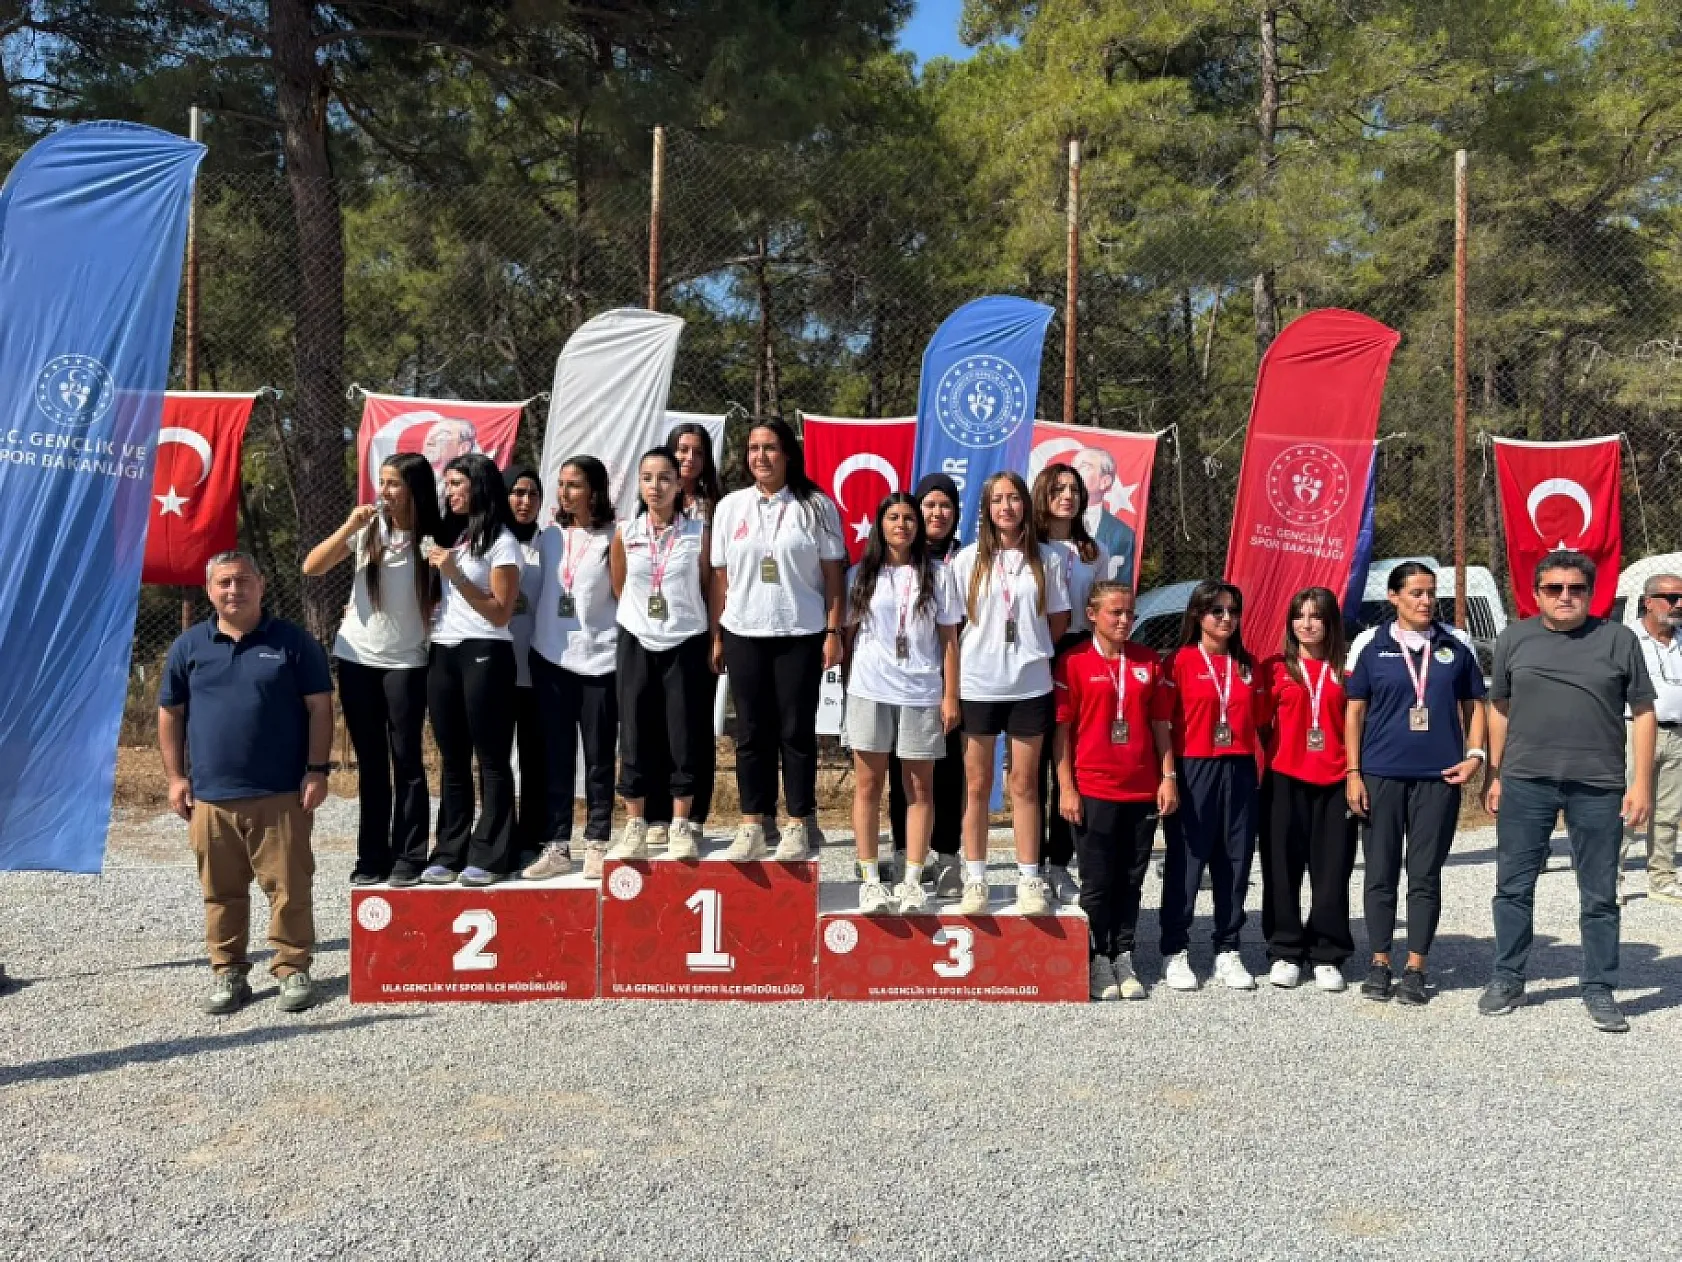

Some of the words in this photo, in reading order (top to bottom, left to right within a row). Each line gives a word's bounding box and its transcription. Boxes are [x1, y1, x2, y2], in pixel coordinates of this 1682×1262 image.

[0, 428, 23, 444] .C.
[30, 431, 115, 456] GENÇLİK
[121, 441, 147, 461] VE
[0, 448, 36, 466] POR
[1249, 535, 1280, 548] SPOR
[1327, 536, 1343, 549] VE
[685, 889, 736, 972] 1
[452, 908, 498, 971] 2
[932, 924, 975, 978] 3
[381, 982, 401, 993] ULA
[446, 982, 457, 992] VE
[459, 982, 485, 992] SPOR
[612, 983, 632, 993] ULA
[678, 983, 691, 993] VE
[692, 983, 719, 993] SPOR
[926, 985, 938, 995] VE
[940, 986, 964, 995] SPOR
